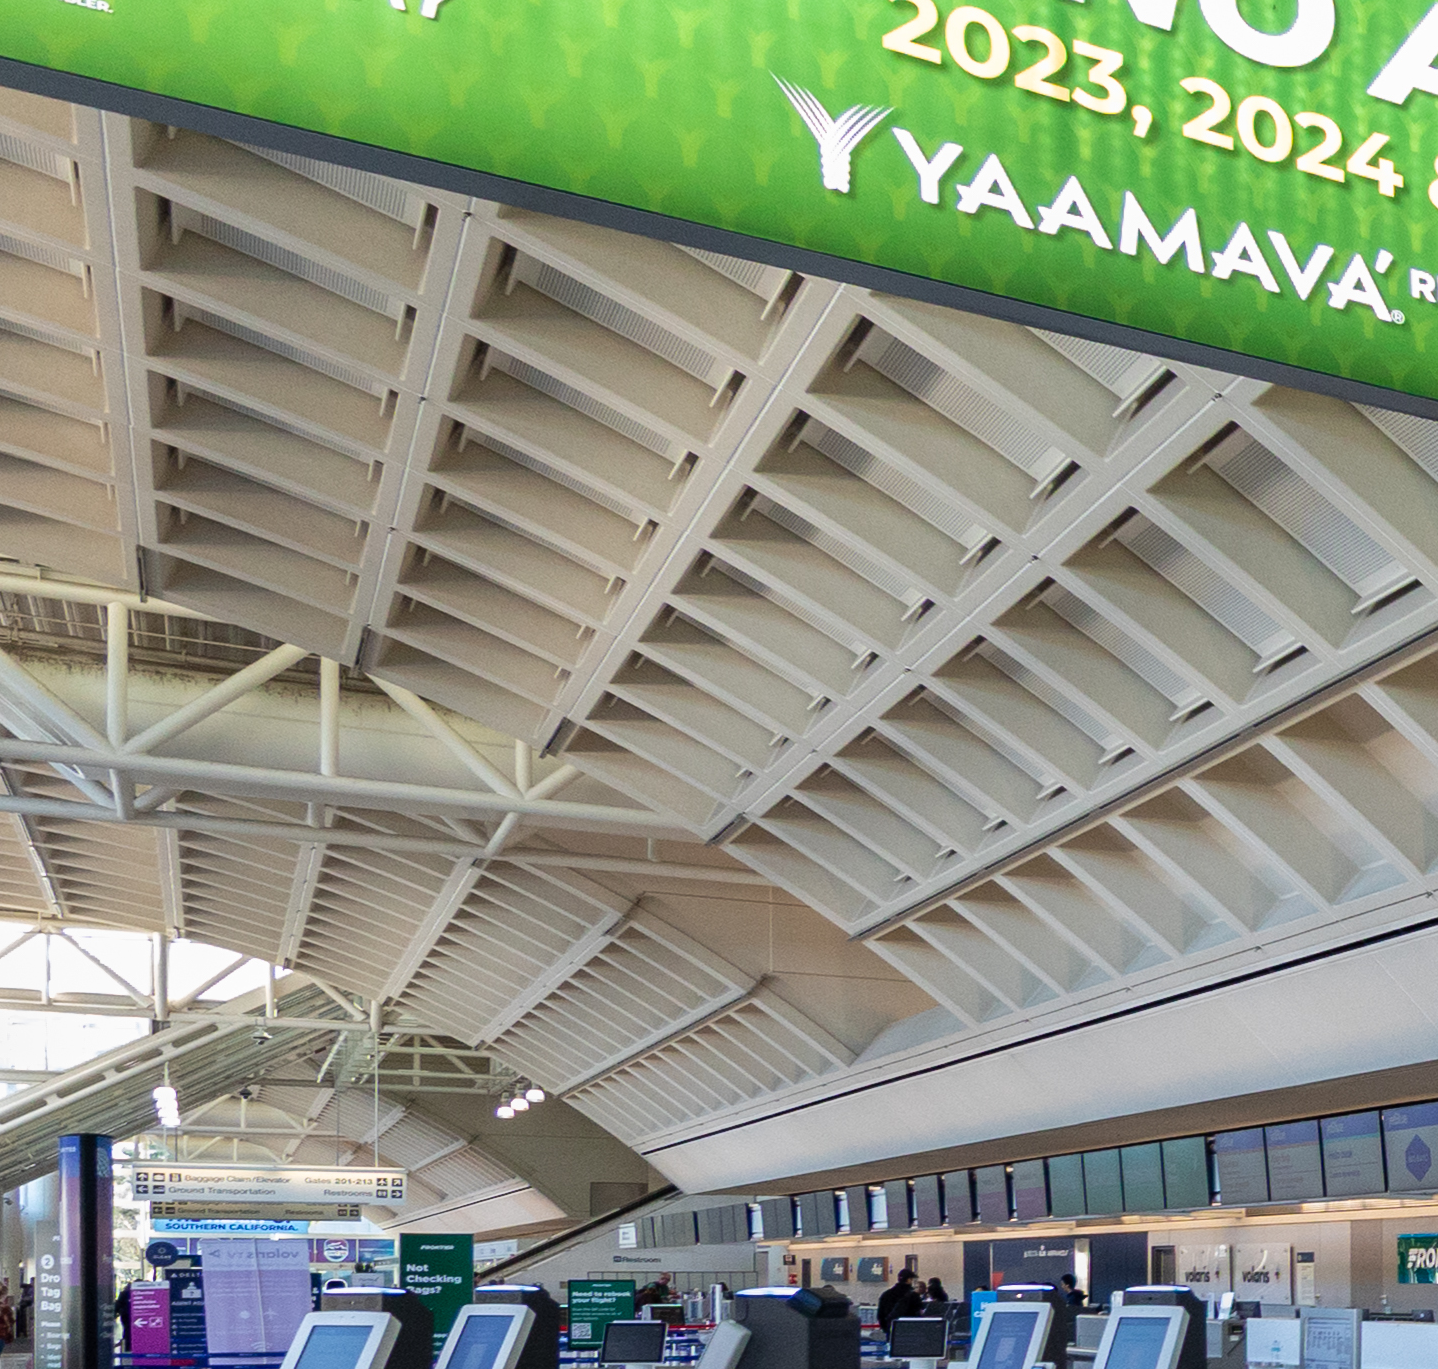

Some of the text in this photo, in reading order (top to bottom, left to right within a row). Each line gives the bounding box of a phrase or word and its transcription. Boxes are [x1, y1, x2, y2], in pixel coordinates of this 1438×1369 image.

[1178, 75, 1405, 198] 2024
[184, 1174, 225, 1184] Baggage
[304, 1177, 331, 1185] Gates
[168, 1186, 373, 1197] Ground Transportation Restrooms
[165, 1222, 226, 1230] SOUTHERN
[406, 1263, 429, 1272] Not
[40, 1273, 61, 1283] Dro
[406, 1274, 462, 1285] Checking
[1184, 1266, 1211, 1283] volaris
[1241, 1266, 1270, 1283] volaris
[40, 1287, 61, 1299] Tag
